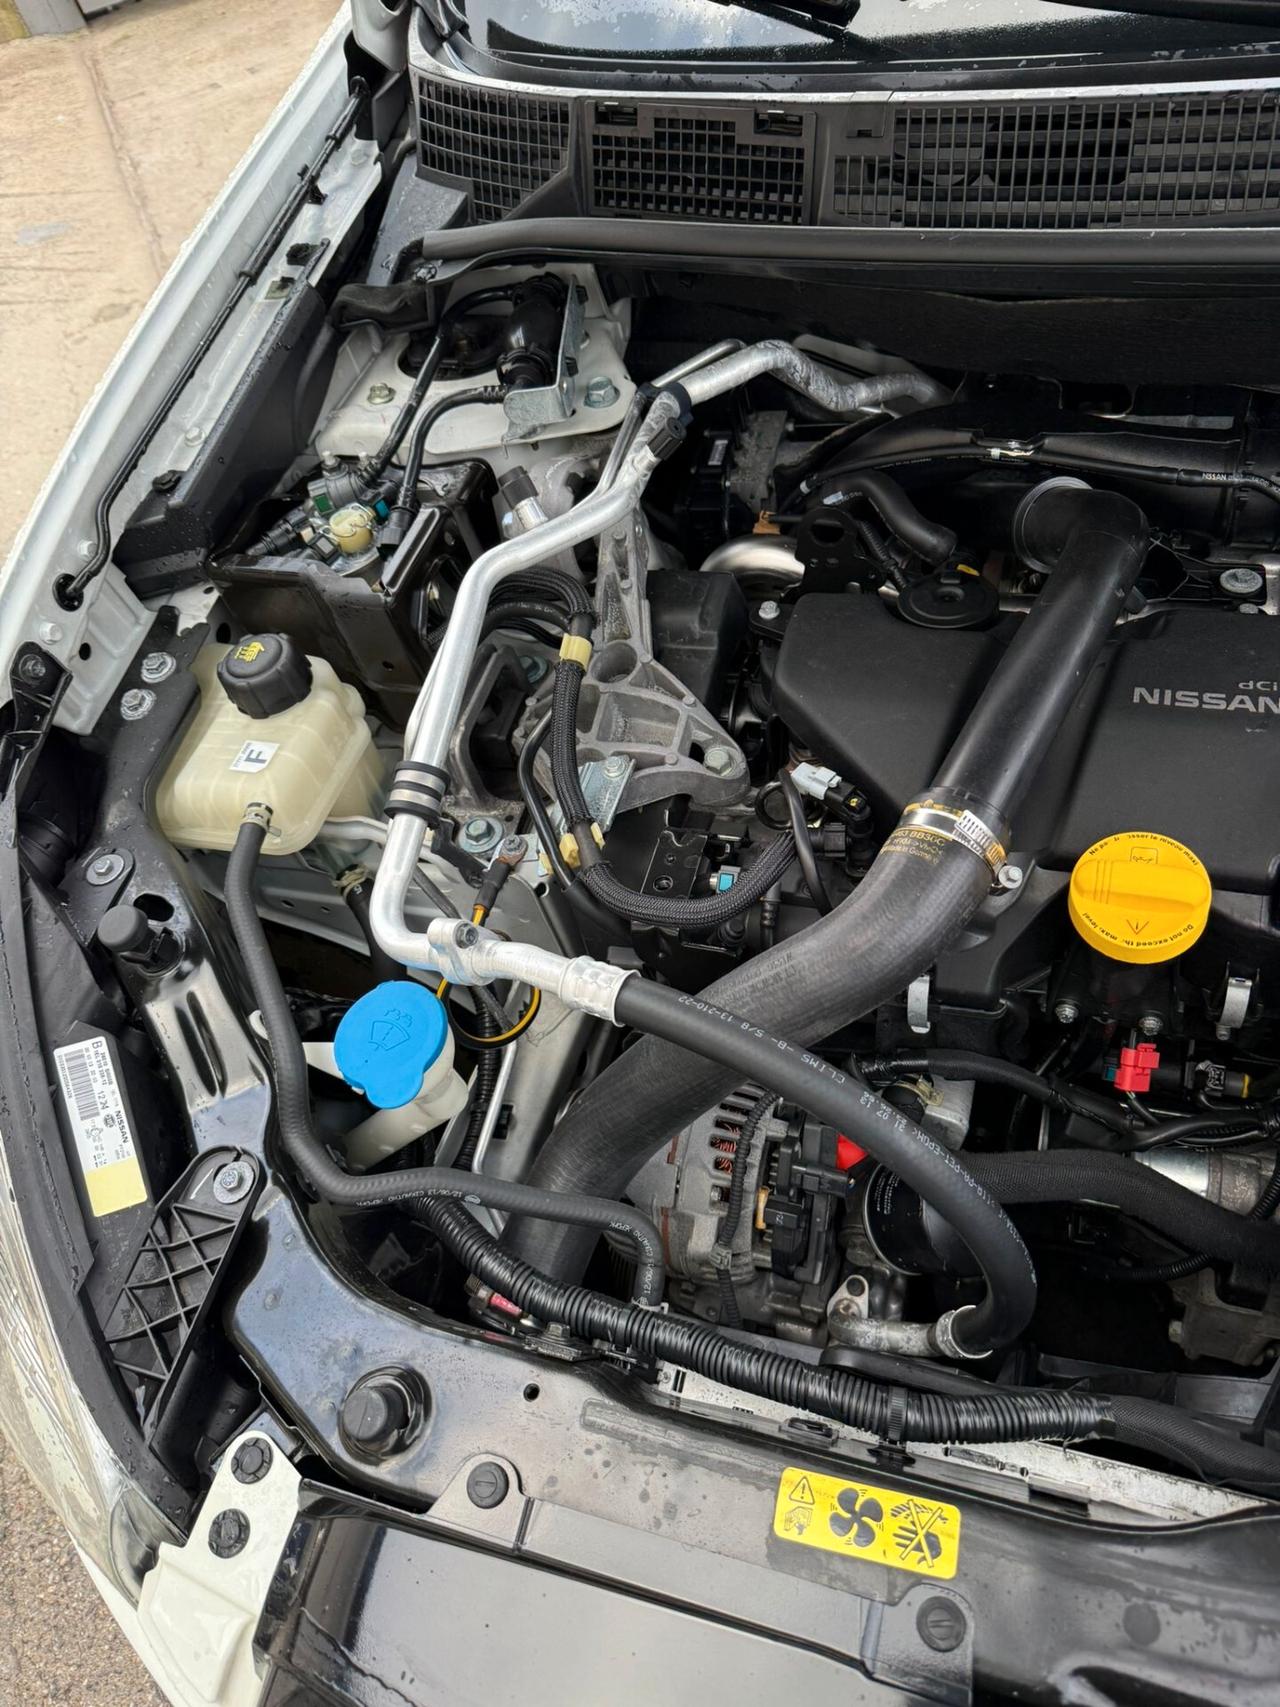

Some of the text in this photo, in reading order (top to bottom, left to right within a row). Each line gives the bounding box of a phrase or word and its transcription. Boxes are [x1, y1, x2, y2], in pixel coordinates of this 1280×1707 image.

[1238, 680, 1278, 691] dCi
[1132, 686, 1280, 714] NISSAN
[740, 1021, 765, 1038] 5/8
[92, 1041, 103, 1050] B
[115, 1110, 129, 1144] NISSAN
